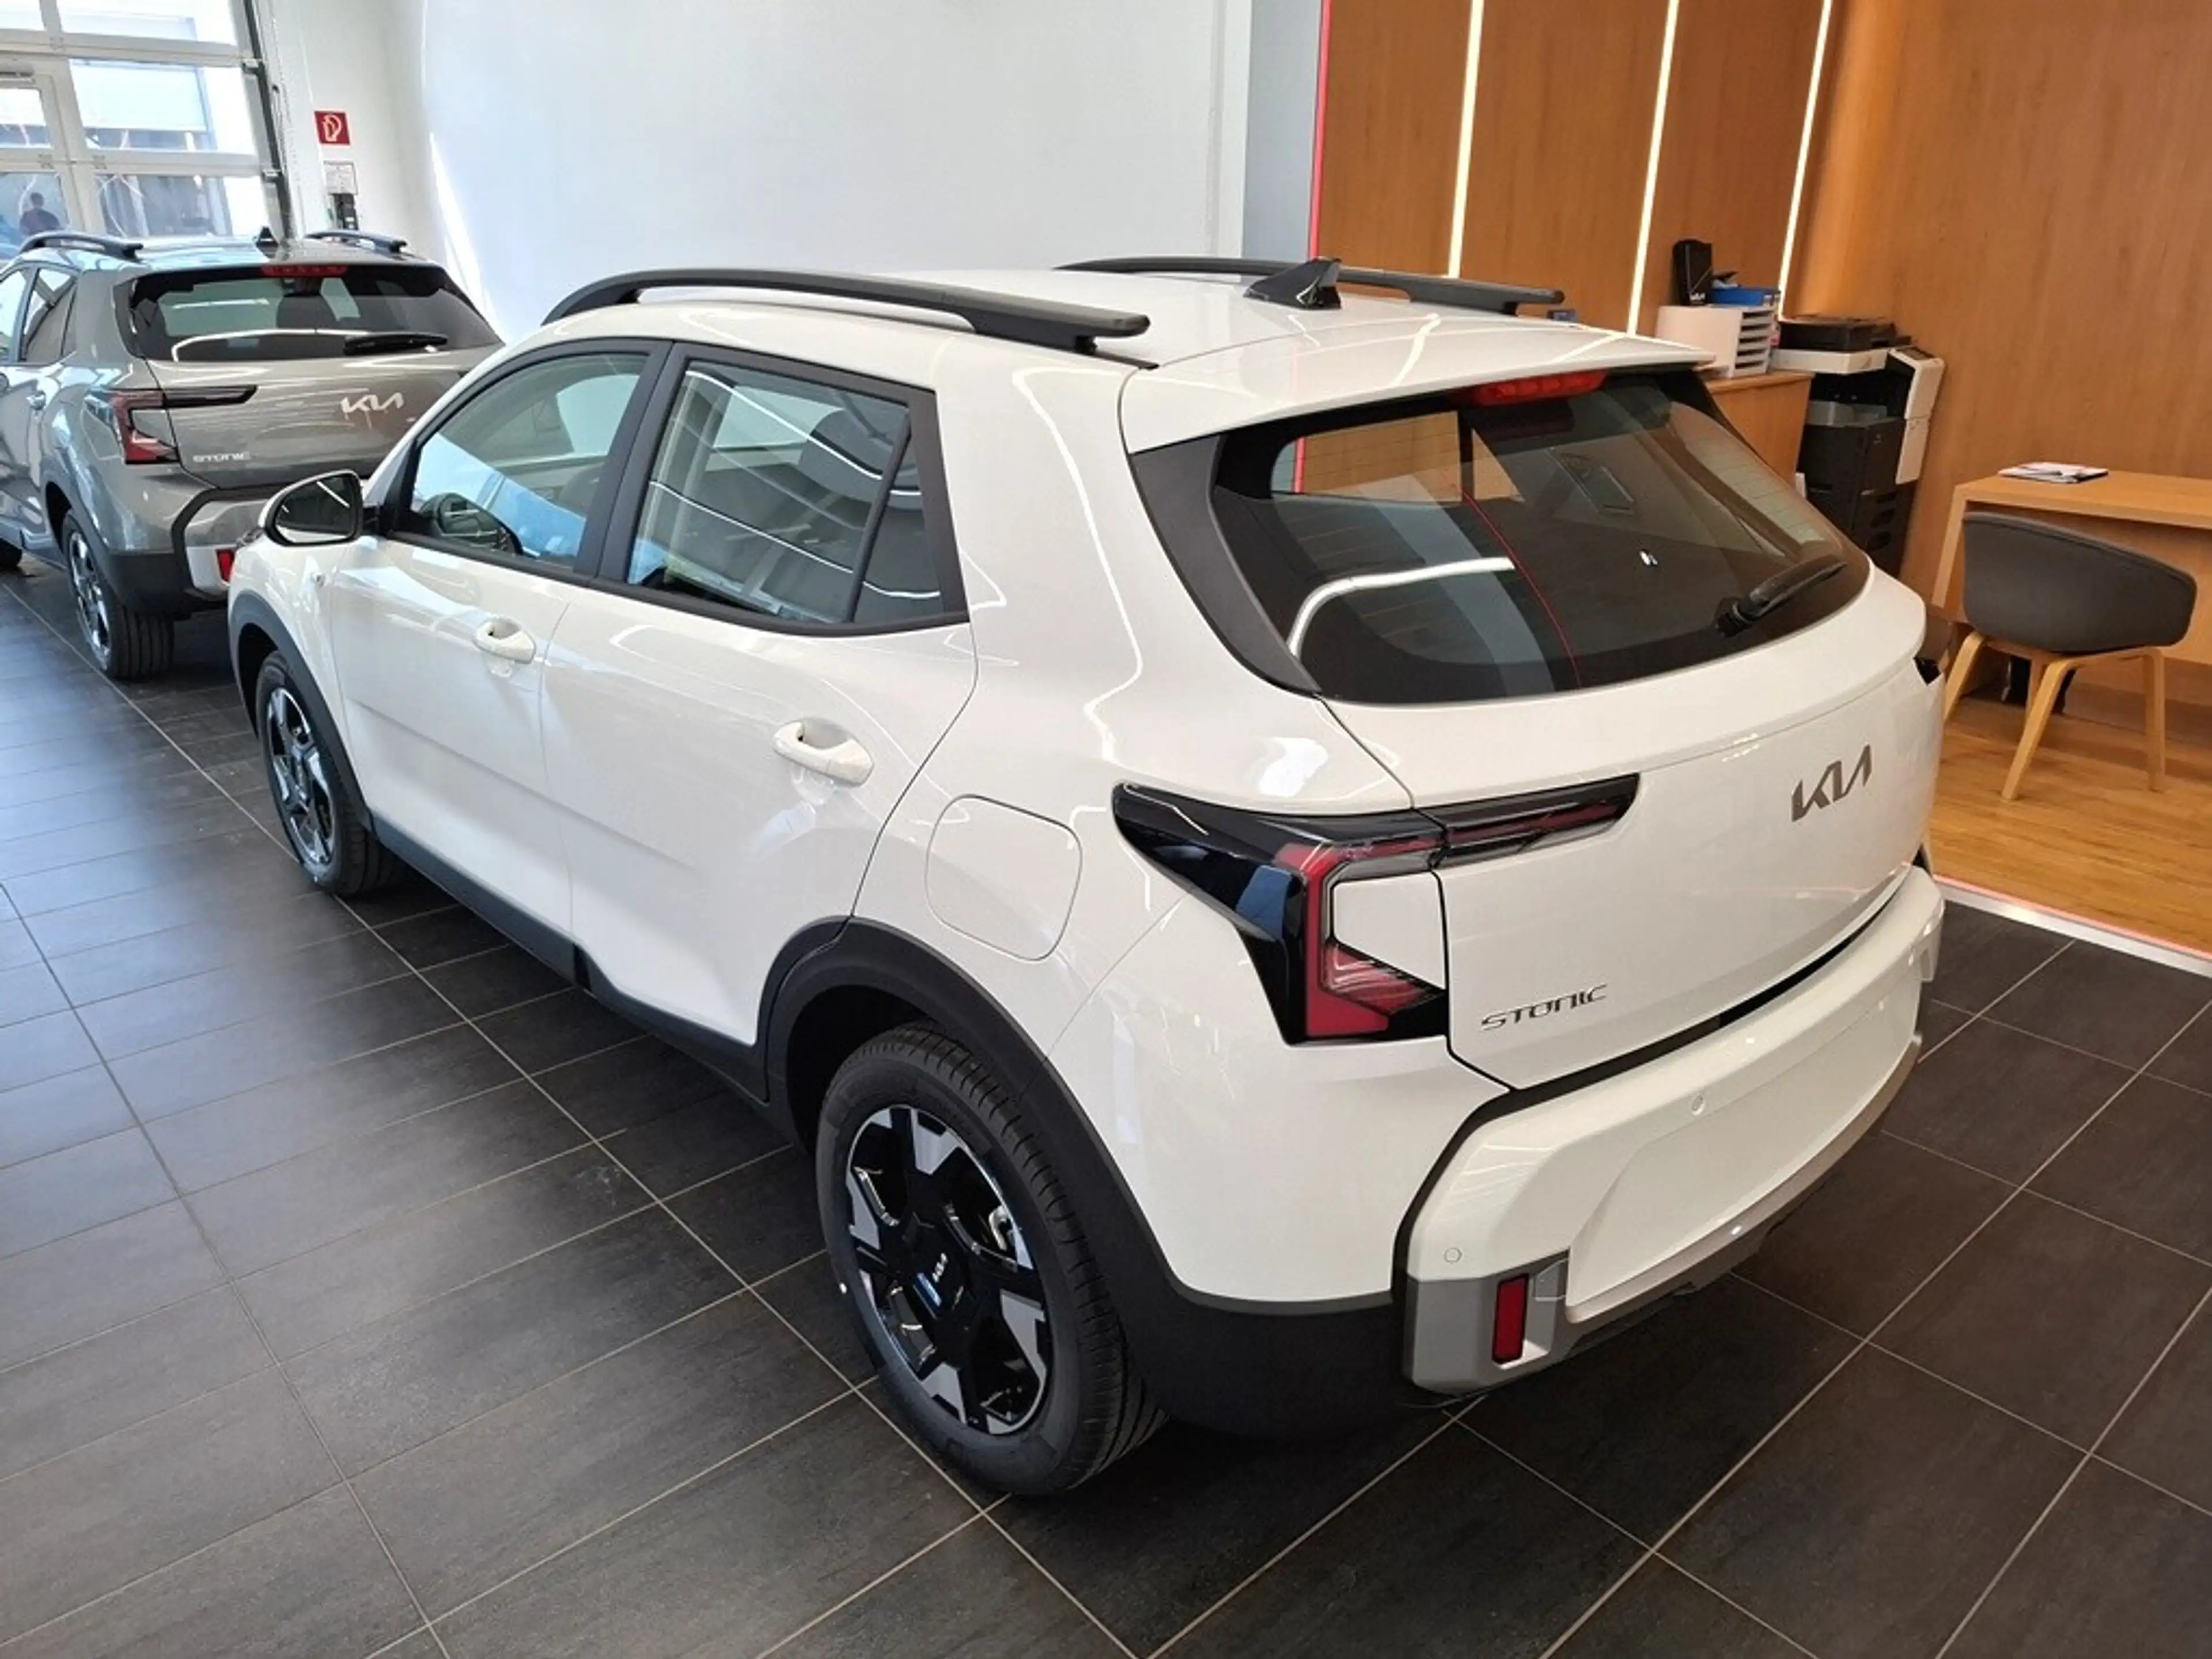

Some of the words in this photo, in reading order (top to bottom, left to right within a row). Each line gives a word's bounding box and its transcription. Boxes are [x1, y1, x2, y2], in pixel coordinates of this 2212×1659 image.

[341, 392, 404, 413] KIA
[1791, 744, 1872, 822] KIA
[1481, 984, 1607, 1031] STONIC
